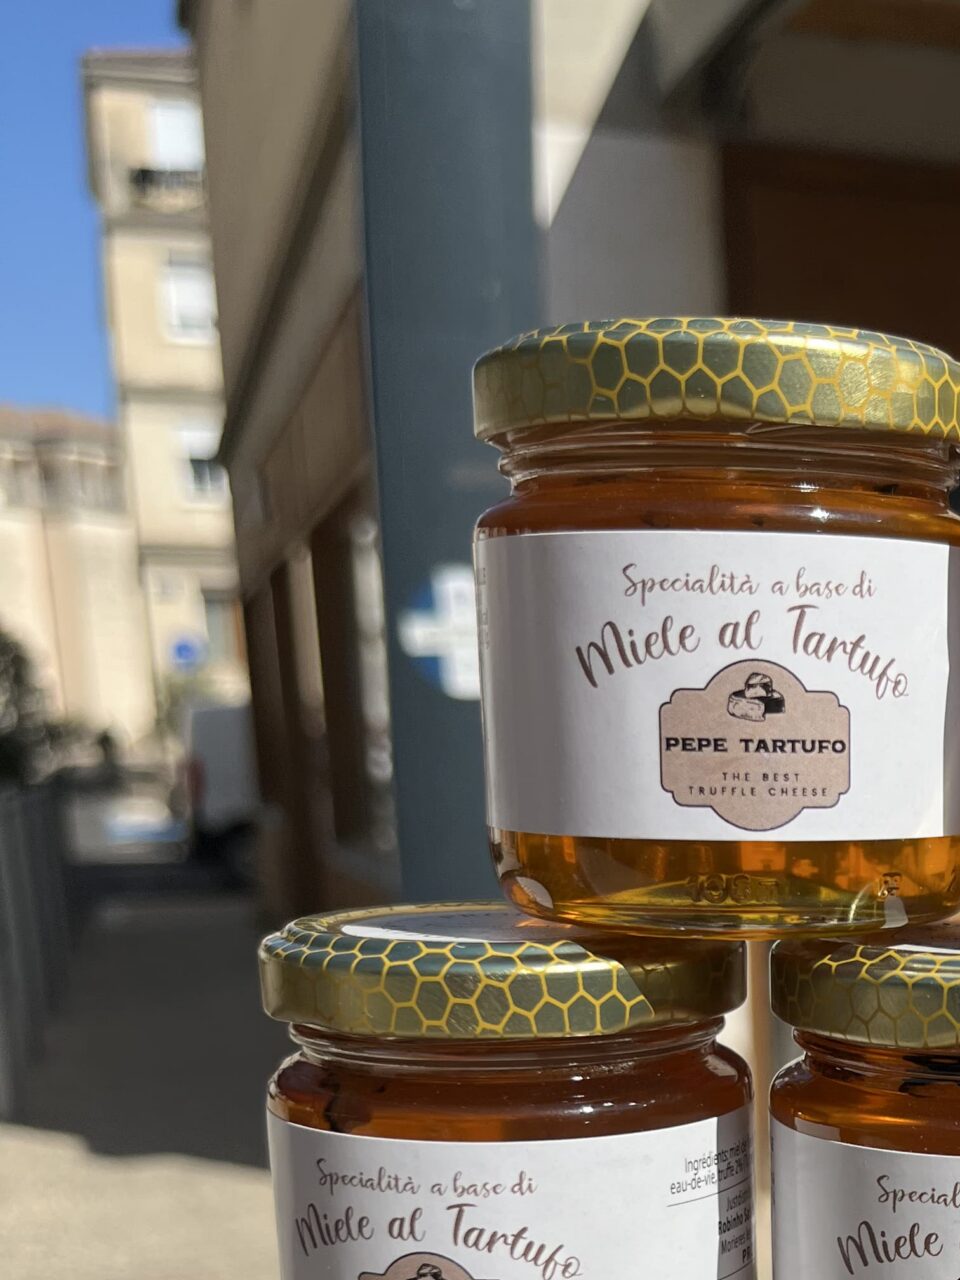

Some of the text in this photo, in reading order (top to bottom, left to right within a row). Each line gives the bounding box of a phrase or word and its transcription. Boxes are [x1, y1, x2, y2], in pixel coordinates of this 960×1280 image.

[622, 563, 877, 605] Specialità a base di
[576, 614, 700, 689] Miele
[718, 609, 763, 651] al
[787, 604, 908, 700] Tartufo
[665, 737, 846, 754] PEPE TARTUFO
[688, 786, 829, 797] TRUFFLE CHEESE
[722, 772, 800, 782] THE BEST
[316, 1158, 537, 1198] Specialità a base di
[296, 1202, 374, 1257] Miele
[388, 1207, 426, 1242] al
[836, 1220, 944, 1276] Miele
